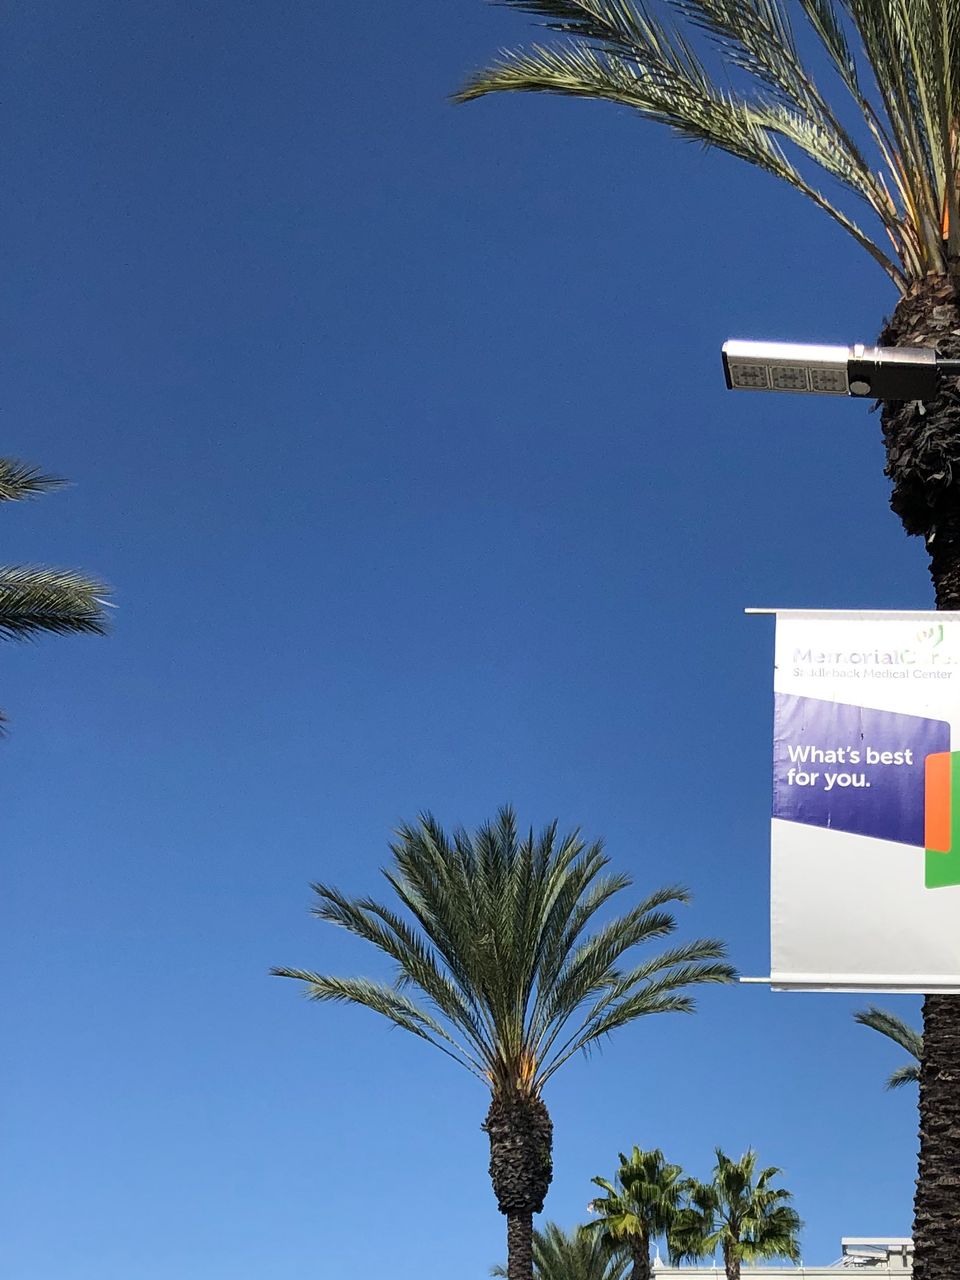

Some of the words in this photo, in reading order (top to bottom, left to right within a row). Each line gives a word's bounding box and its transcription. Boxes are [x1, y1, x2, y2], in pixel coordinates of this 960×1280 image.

[787, 745, 861, 764] What’s
[866, 747, 914, 765] best
[787, 768, 820, 786] for
[824, 773, 871, 791] you.
